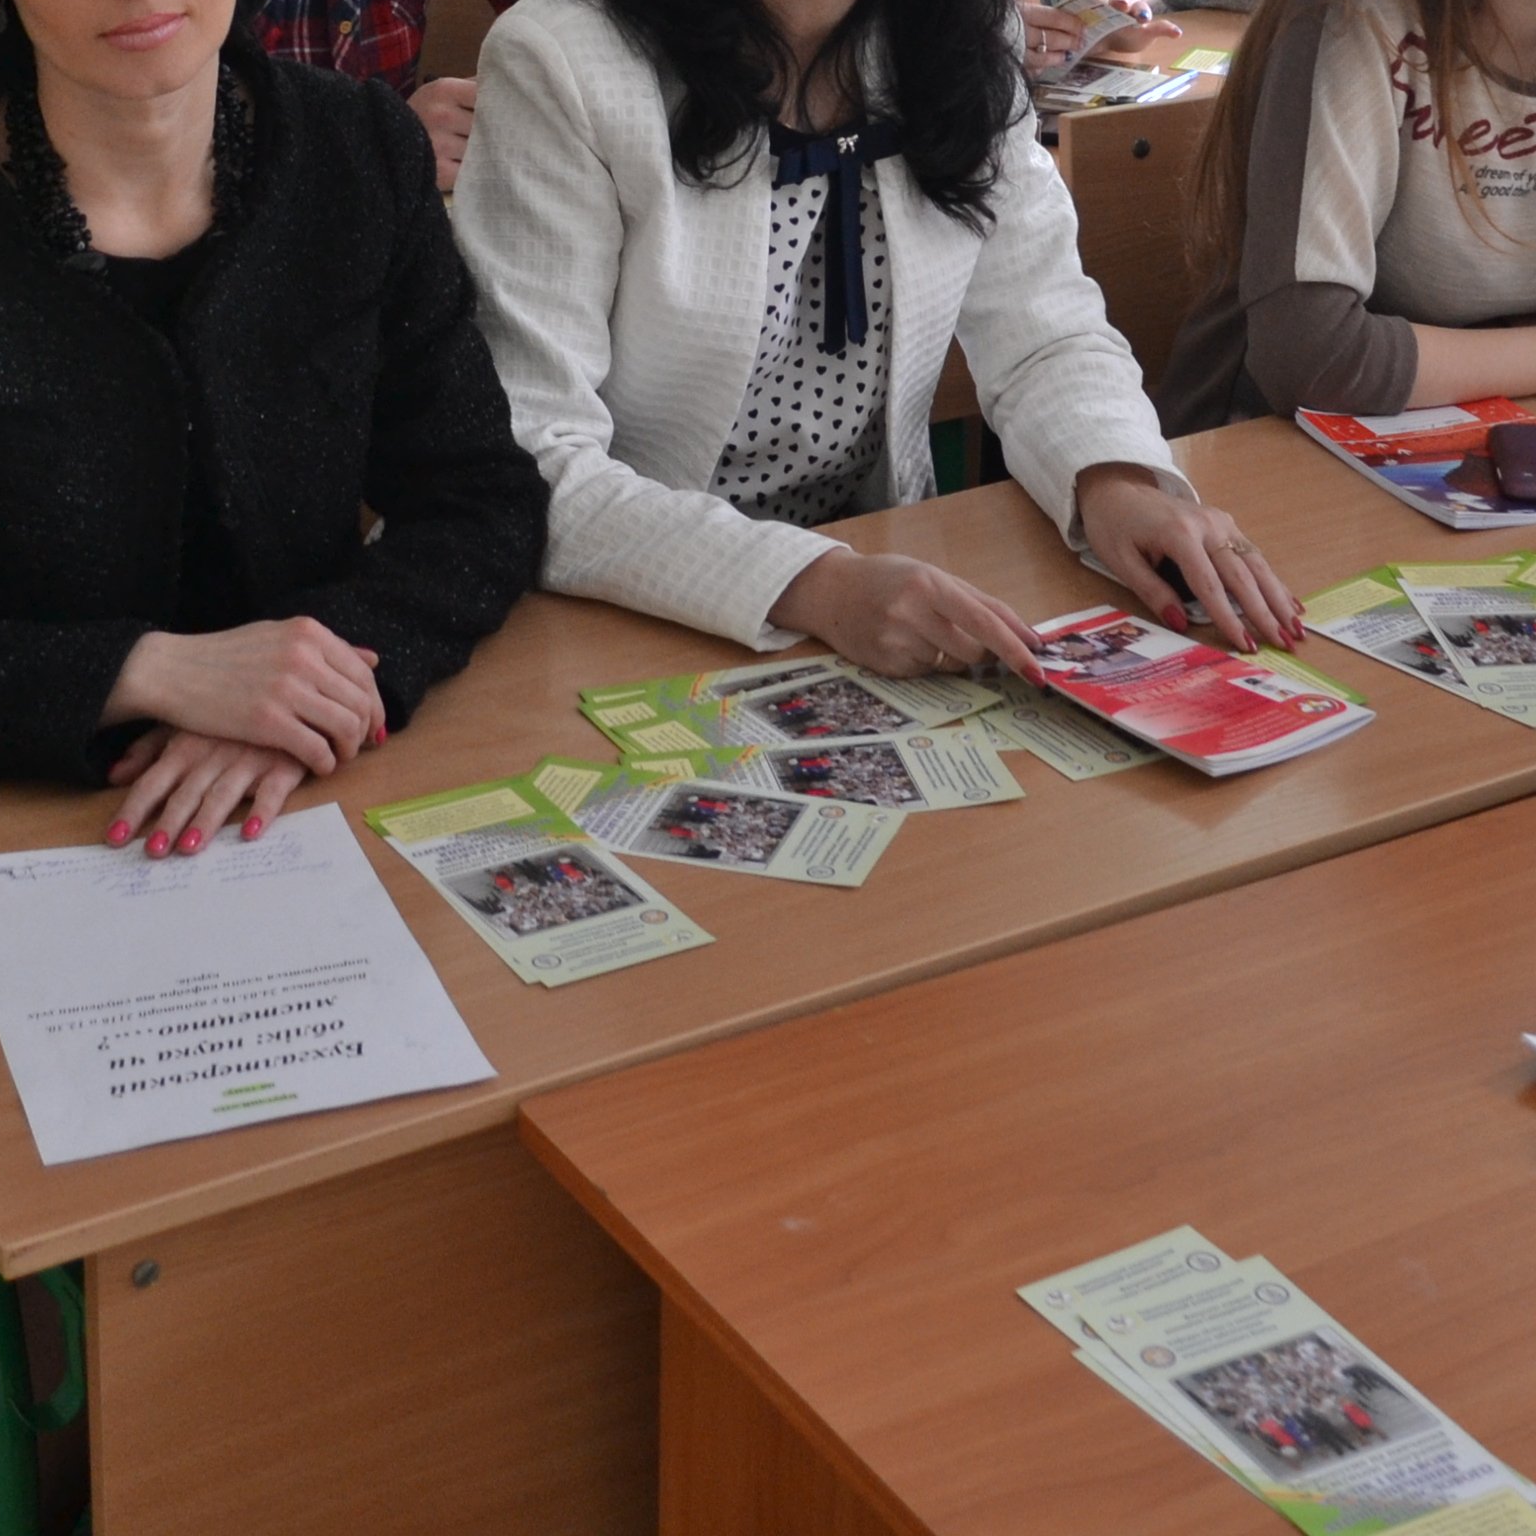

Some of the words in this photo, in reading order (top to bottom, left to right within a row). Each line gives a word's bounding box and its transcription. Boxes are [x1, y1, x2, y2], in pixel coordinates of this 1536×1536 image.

[257, 1020, 344, 1044] облік:
[158, 1038, 243, 1061] наука
[110, 1056, 145, 1070] чи
[111, 1042, 362, 1097] Бухгалтерський
